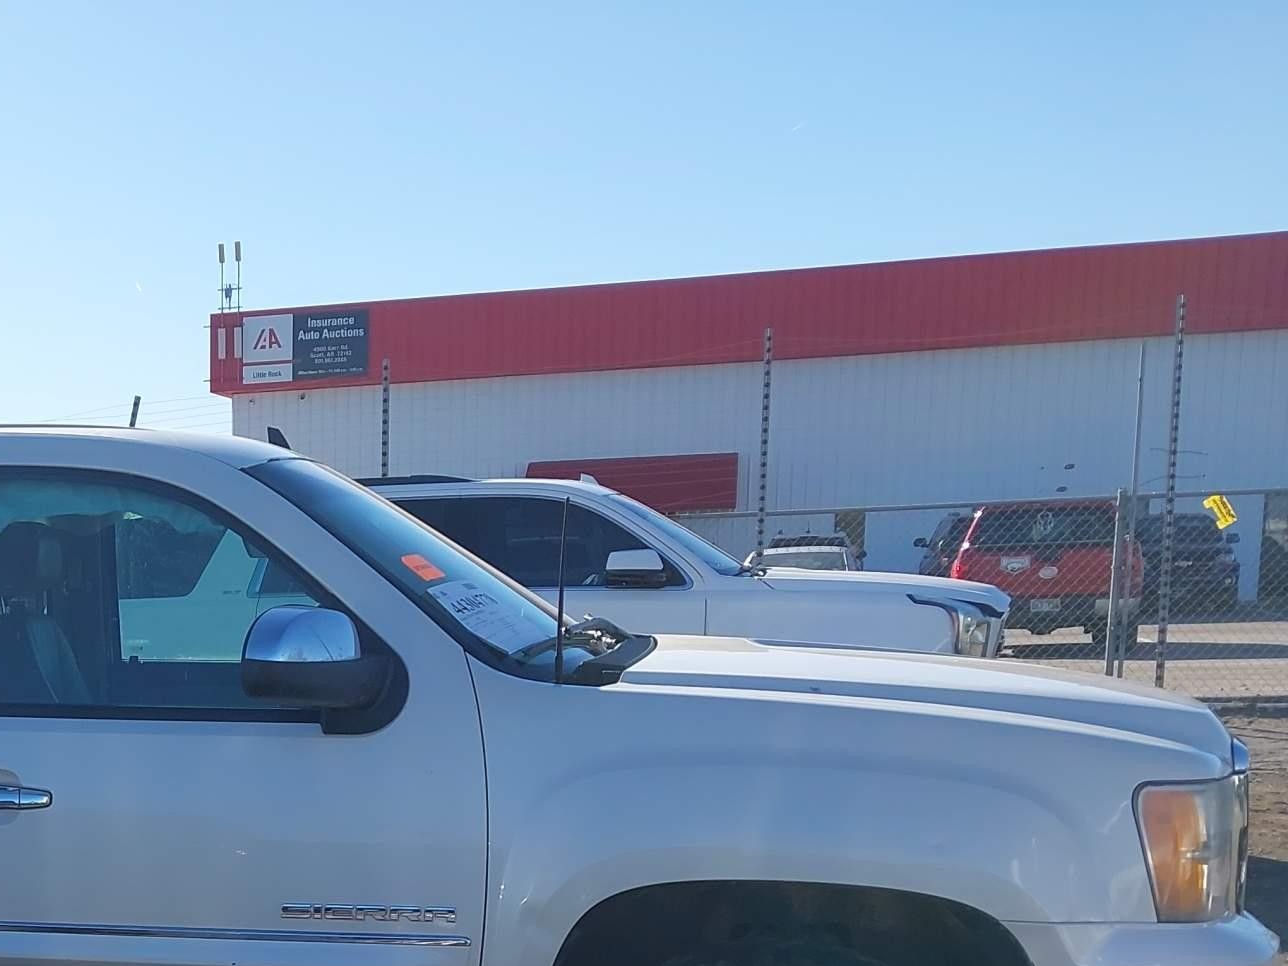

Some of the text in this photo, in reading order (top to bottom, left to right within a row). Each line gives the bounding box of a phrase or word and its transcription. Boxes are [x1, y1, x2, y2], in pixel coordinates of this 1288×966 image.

[308, 317, 355, 327] Insurance
[298, 328, 364, 341] Auto Auctions
[268, 369, 282, 377] Rock
[280, 903, 457, 923] SIERRA
